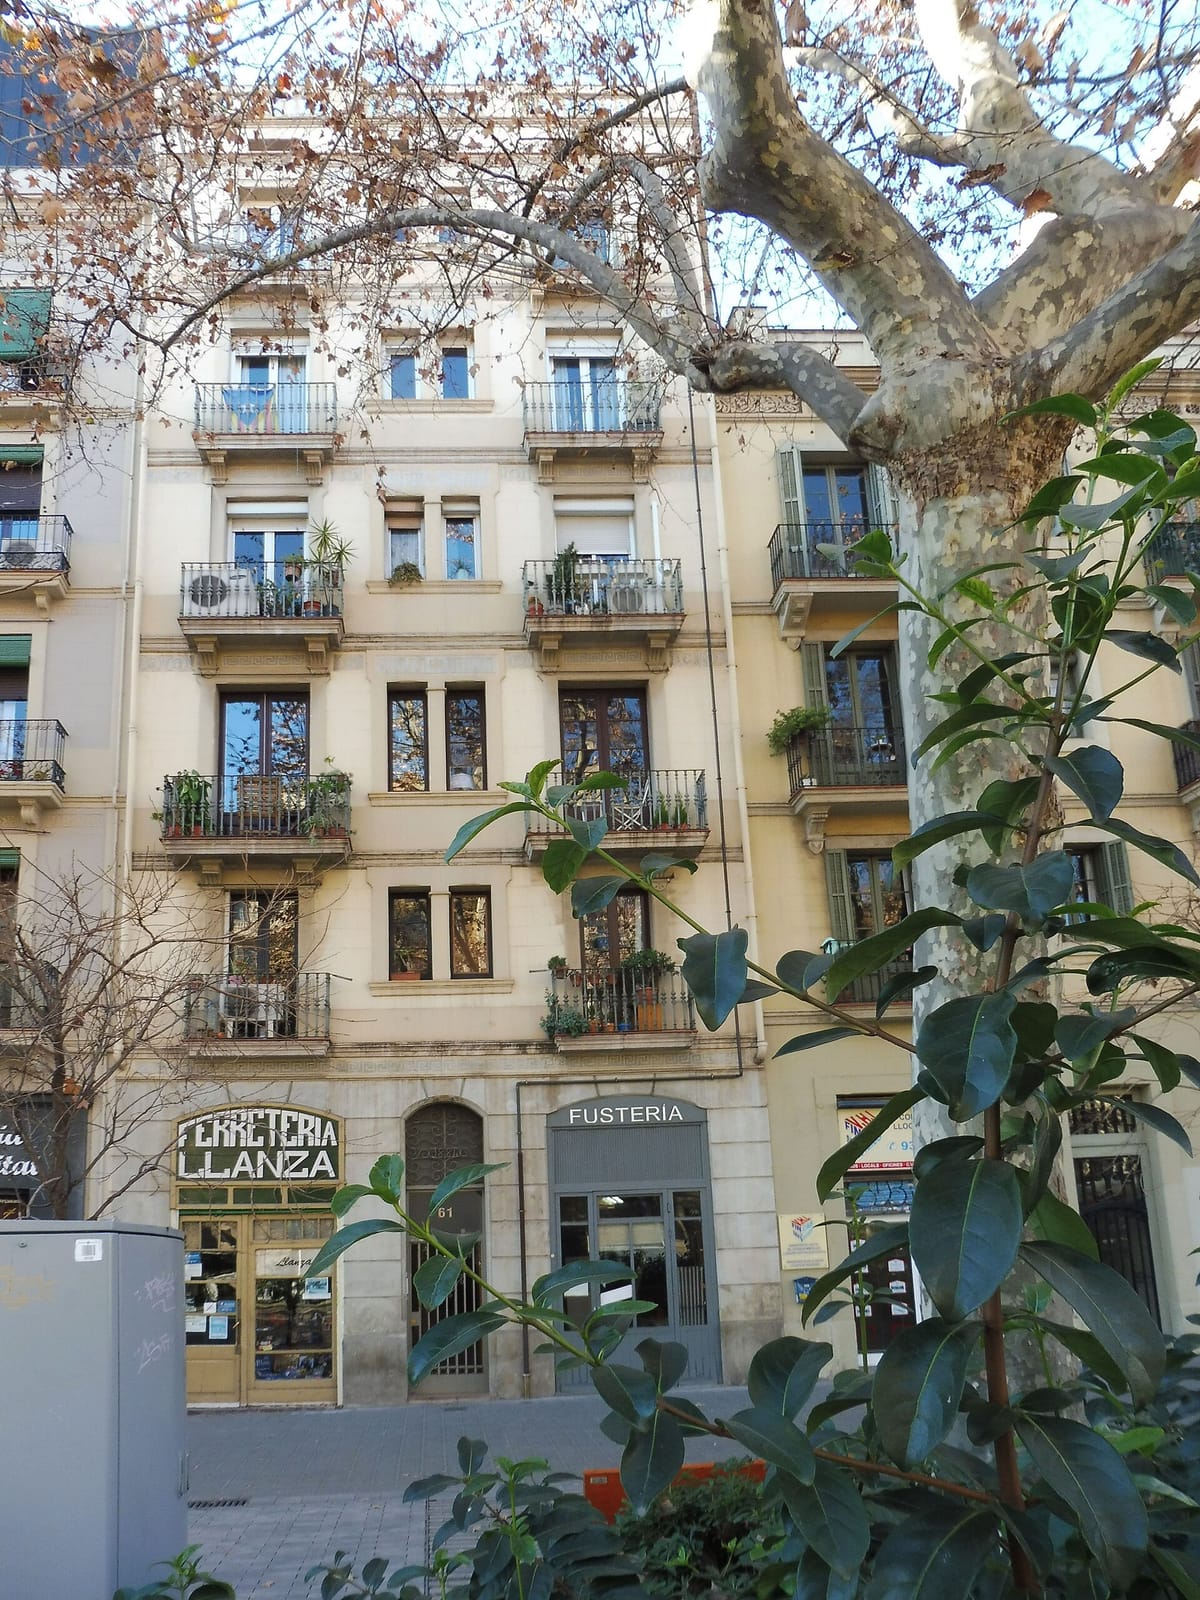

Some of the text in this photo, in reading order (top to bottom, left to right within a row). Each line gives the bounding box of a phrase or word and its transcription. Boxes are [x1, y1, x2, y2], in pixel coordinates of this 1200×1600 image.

[569, 1103, 684, 1124] FUSTERÍA
[178, 1108, 338, 1147] FERRETERIA
[178, 1150, 336, 1178] LLANZA
[438, 1207, 453, 1218] 61
